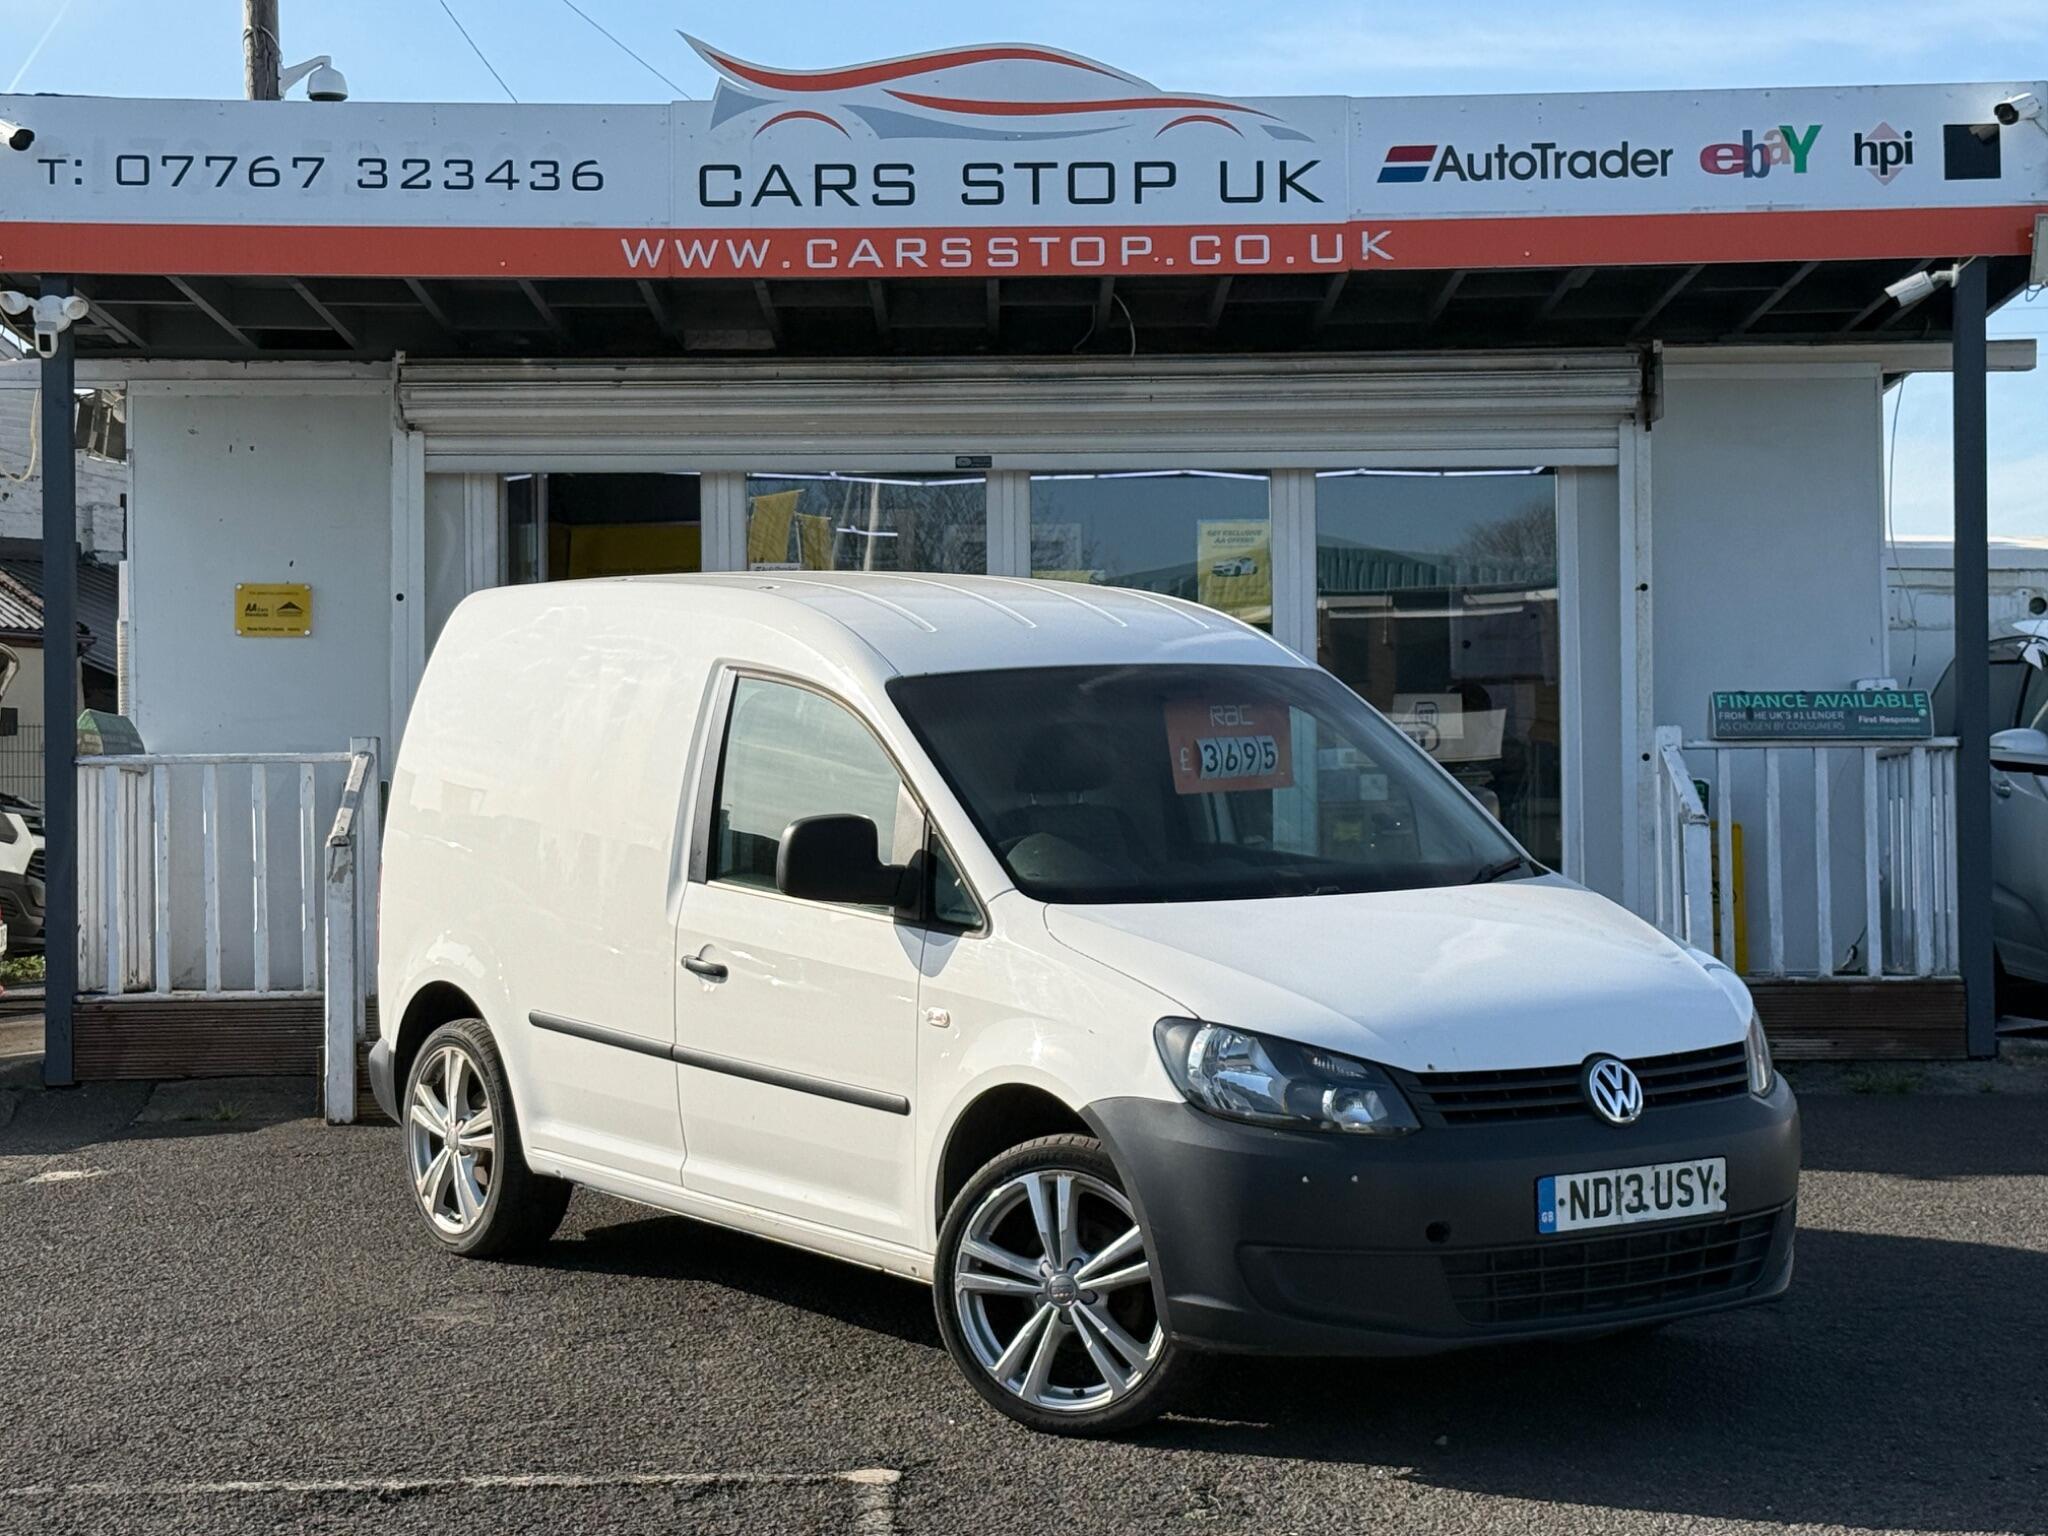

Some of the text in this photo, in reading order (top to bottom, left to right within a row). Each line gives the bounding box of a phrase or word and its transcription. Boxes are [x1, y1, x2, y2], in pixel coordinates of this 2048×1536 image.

[1432, 141, 1674, 182] AutoTrader
[1854, 130, 1914, 177] hpi
[37, 155, 605, 191] T: 07767 323436
[699, 160, 1325, 208] CARS STOP UK
[1716, 693, 1927, 709] FINANCE AVAILABLE
[1719, 711, 1746, 720] FROM
[1747, 711, 1768, 720] HE
[1806, 711, 1845, 720] LENDER
[1858, 715, 1878, 723] First
[1203, 741, 1277, 773] 3695
[1654, 1165, 1714, 1211] USY
